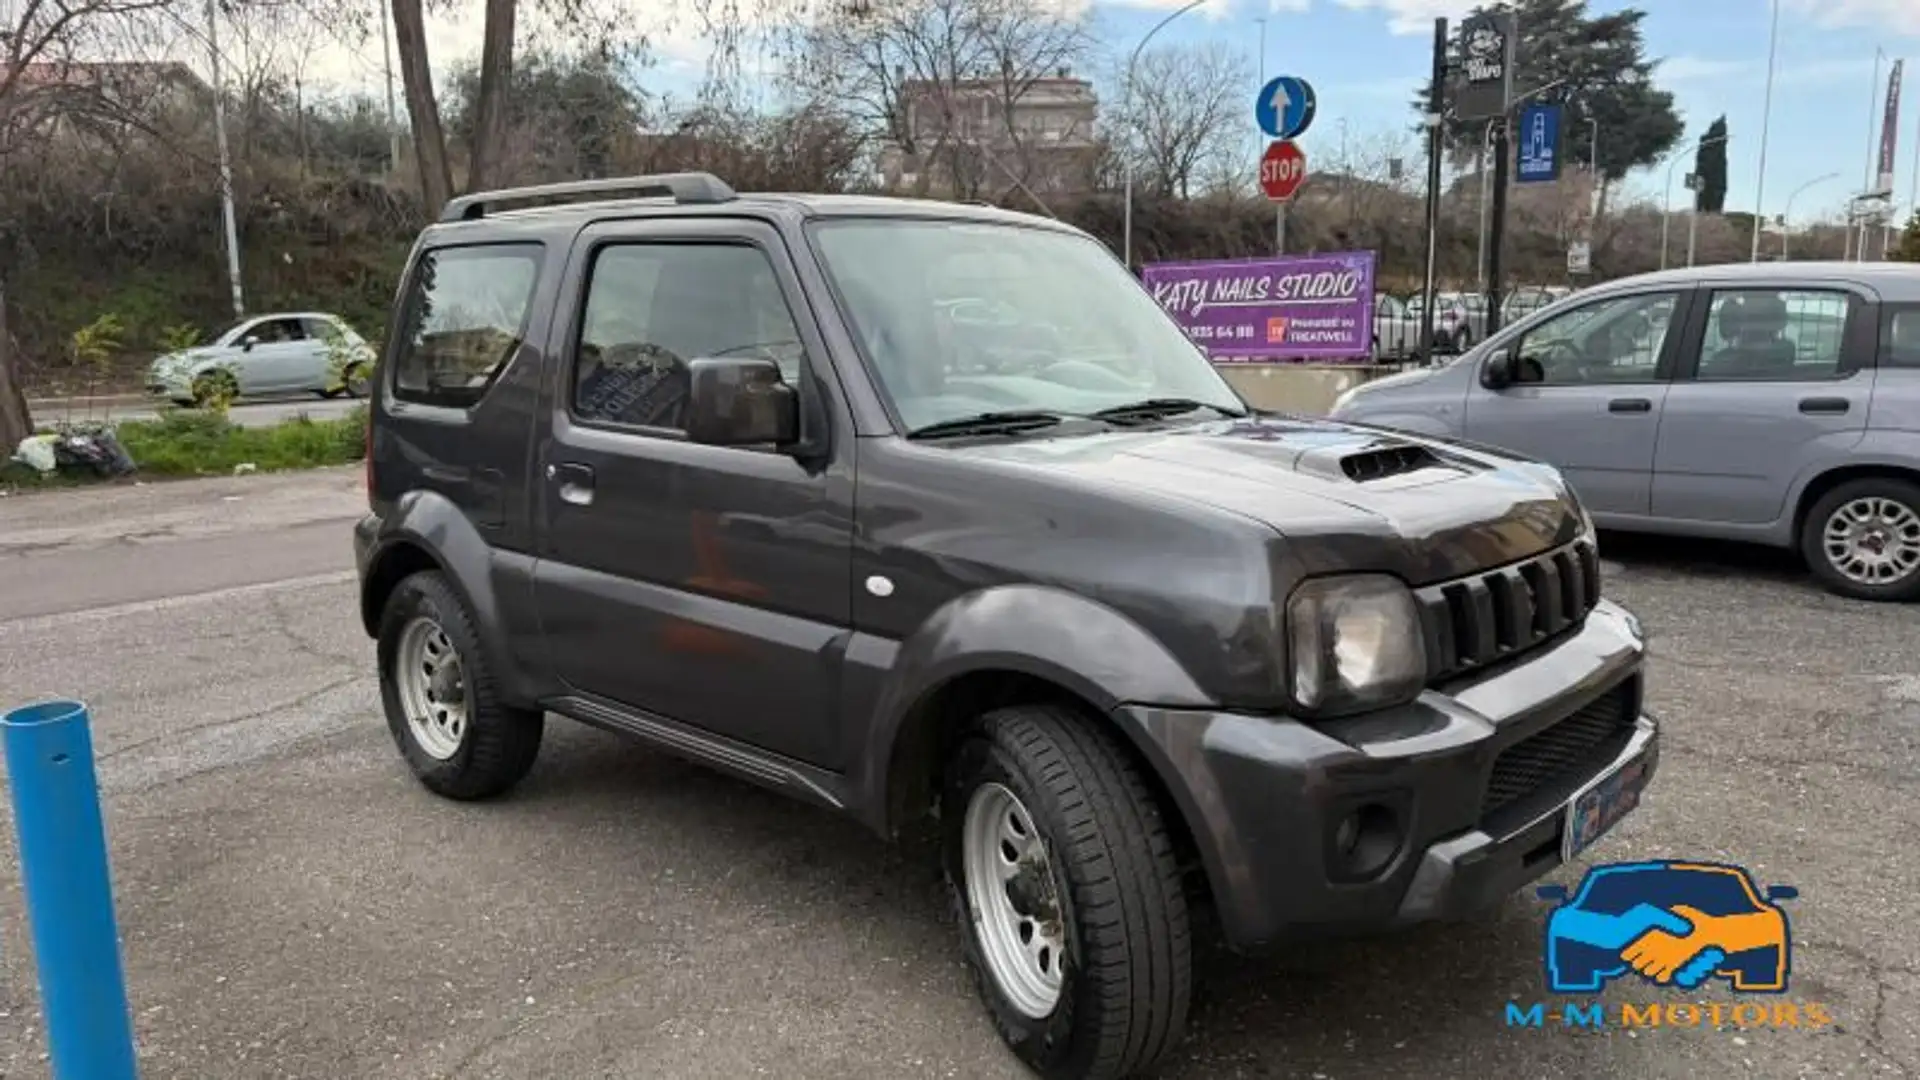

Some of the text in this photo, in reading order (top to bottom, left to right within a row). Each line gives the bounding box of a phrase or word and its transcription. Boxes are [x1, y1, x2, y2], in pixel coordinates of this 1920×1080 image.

[1262, 157, 1302, 182] STOP
[1153, 271, 1358, 317] KATY NAILS STUDIO
